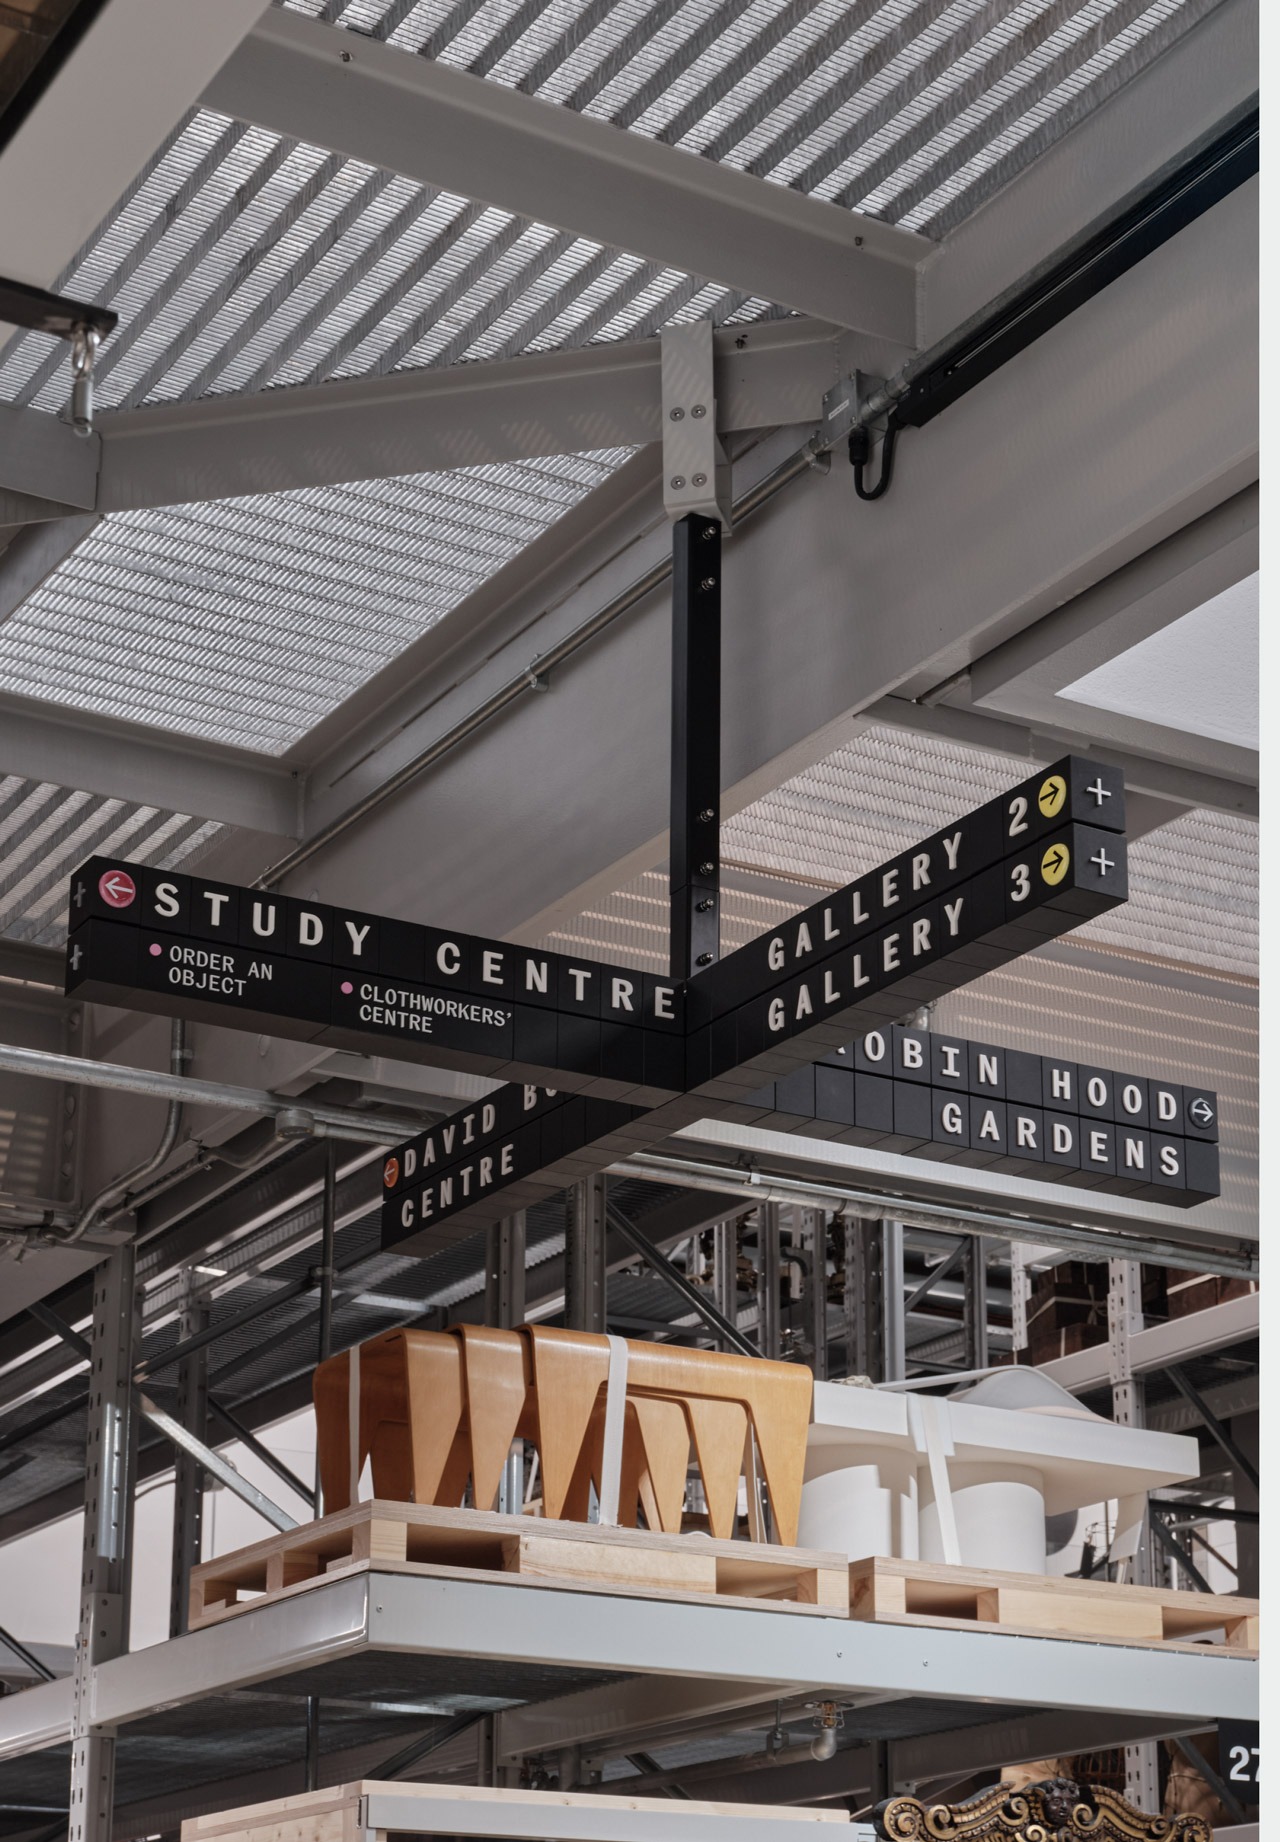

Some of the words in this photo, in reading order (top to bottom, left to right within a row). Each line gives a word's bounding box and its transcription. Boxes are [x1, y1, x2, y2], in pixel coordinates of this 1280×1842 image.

[767, 831, 962, 972] GALLERY
[1009, 796, 1028, 836] 2
[154, 881, 371, 956] STUDY
[436, 941, 676, 1019] CENTRE
[168, 966, 247, 997] OBJECT
[169, 945, 235, 974] ORDER
[247, 961, 273, 981] AN
[767, 897, 964, 1032] GALLERY
[1010, 863, 1031, 902] 3
[359, 1003, 433, 1034] CENTRE
[837, 1031, 998, 1086] OBIN
[1052, 1068, 1177, 1121] HOOD
[404, 1103, 496, 1178] DAVID
[942, 1102, 1180, 1177] GARDENS
[401, 1142, 514, 1229] CENTRE
